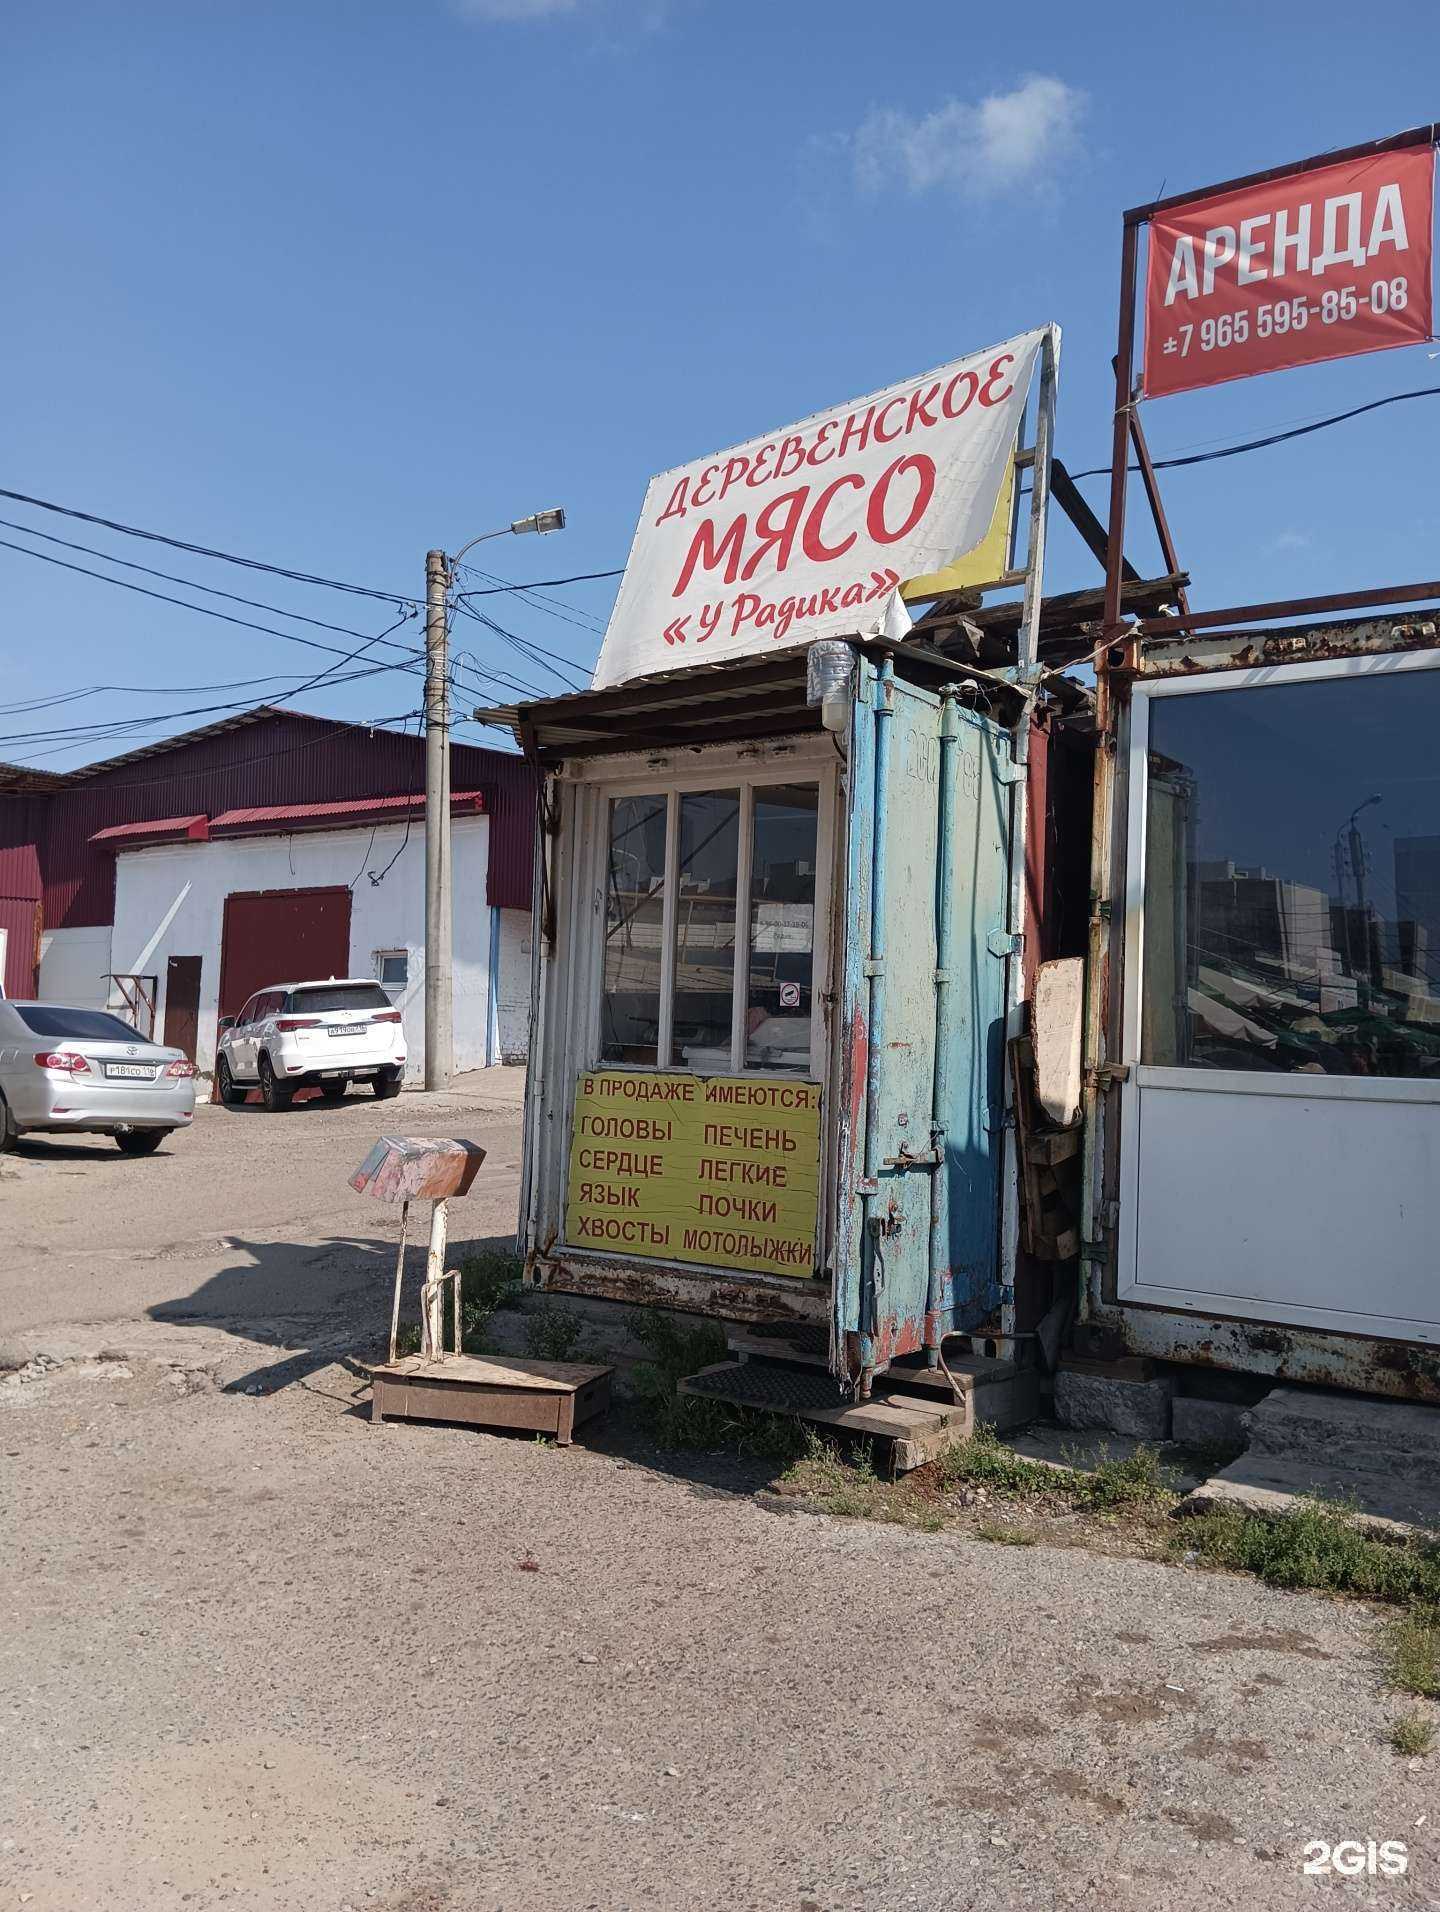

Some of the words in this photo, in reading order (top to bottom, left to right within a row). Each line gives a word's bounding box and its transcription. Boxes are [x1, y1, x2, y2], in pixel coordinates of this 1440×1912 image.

[1163, 183, 1409, 307] АРЕНДА
[1200, 310, 1249, 353] 965
[1256, 276, 1408, 339] 595-85-08
[655, 353, 1015, 528] ДЕРЕВЕНСКОЕ
[671, 453, 937, 598] МЯСО
[730, 568, 900, 641] Радика»
[583, 1078, 594, 1095] В
[599, 1079, 695, 1102] ПРОДАЖЕ
[705, 1084, 817, 1109] ИМЕЮТСЯ:
[580, 1116, 672, 1141] ГОЛОВЫ
[703, 1124, 797, 1152] ПЕЧЕНЬ
[579, 1149, 664, 1178] СЕРДЦЕ
[698, 1159, 787, 1188] ЛЕГКИЕ
[578, 1182, 641, 1208] ЯЗЫК
[698, 1194, 777, 1223] ПОЧКИ
[577, 1215, 670, 1245] ХВОСТЫ
[682, 1228, 813, 1266] МОТОЛЫЖКИ
